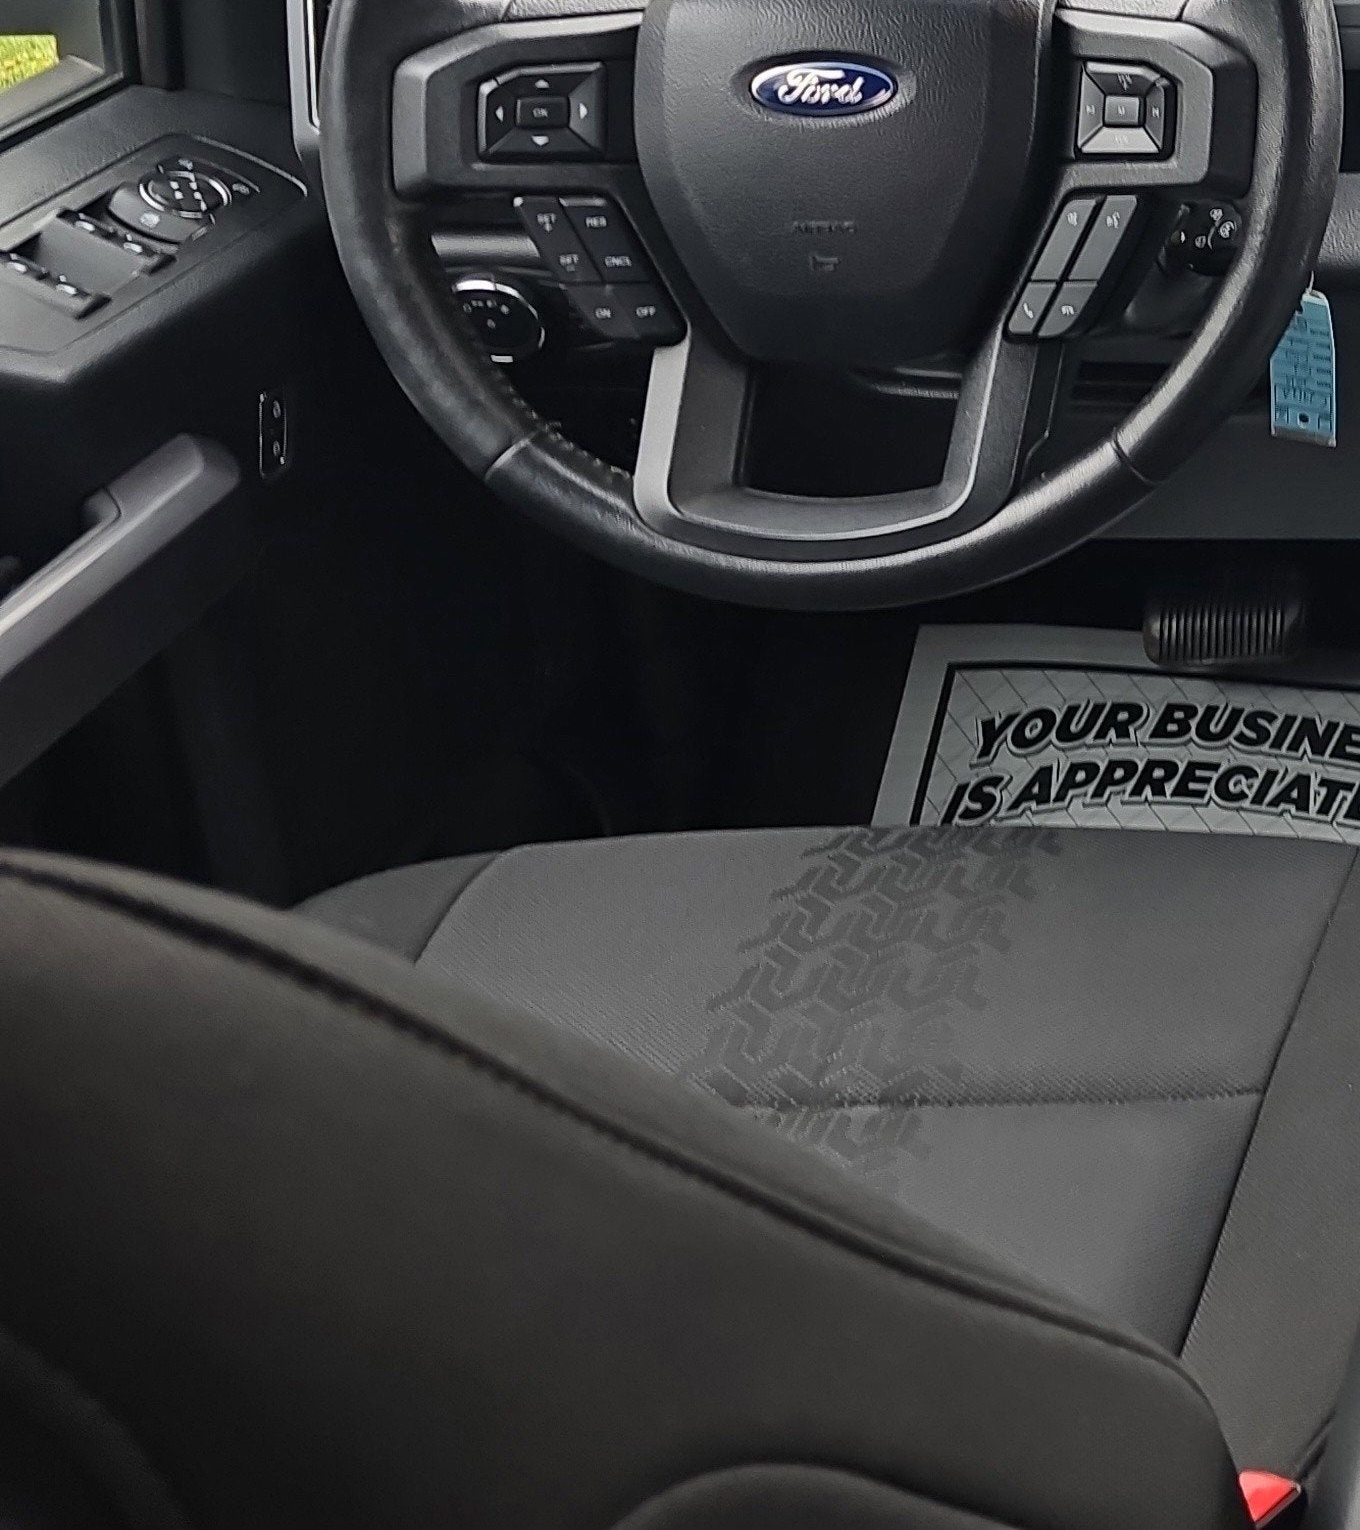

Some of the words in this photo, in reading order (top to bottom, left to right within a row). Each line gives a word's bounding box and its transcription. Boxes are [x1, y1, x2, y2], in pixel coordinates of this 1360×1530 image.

[777, 68, 865, 106] Ford
[977, 702, 1143, 758] YOUR
[942, 775, 1007, 825] IS
